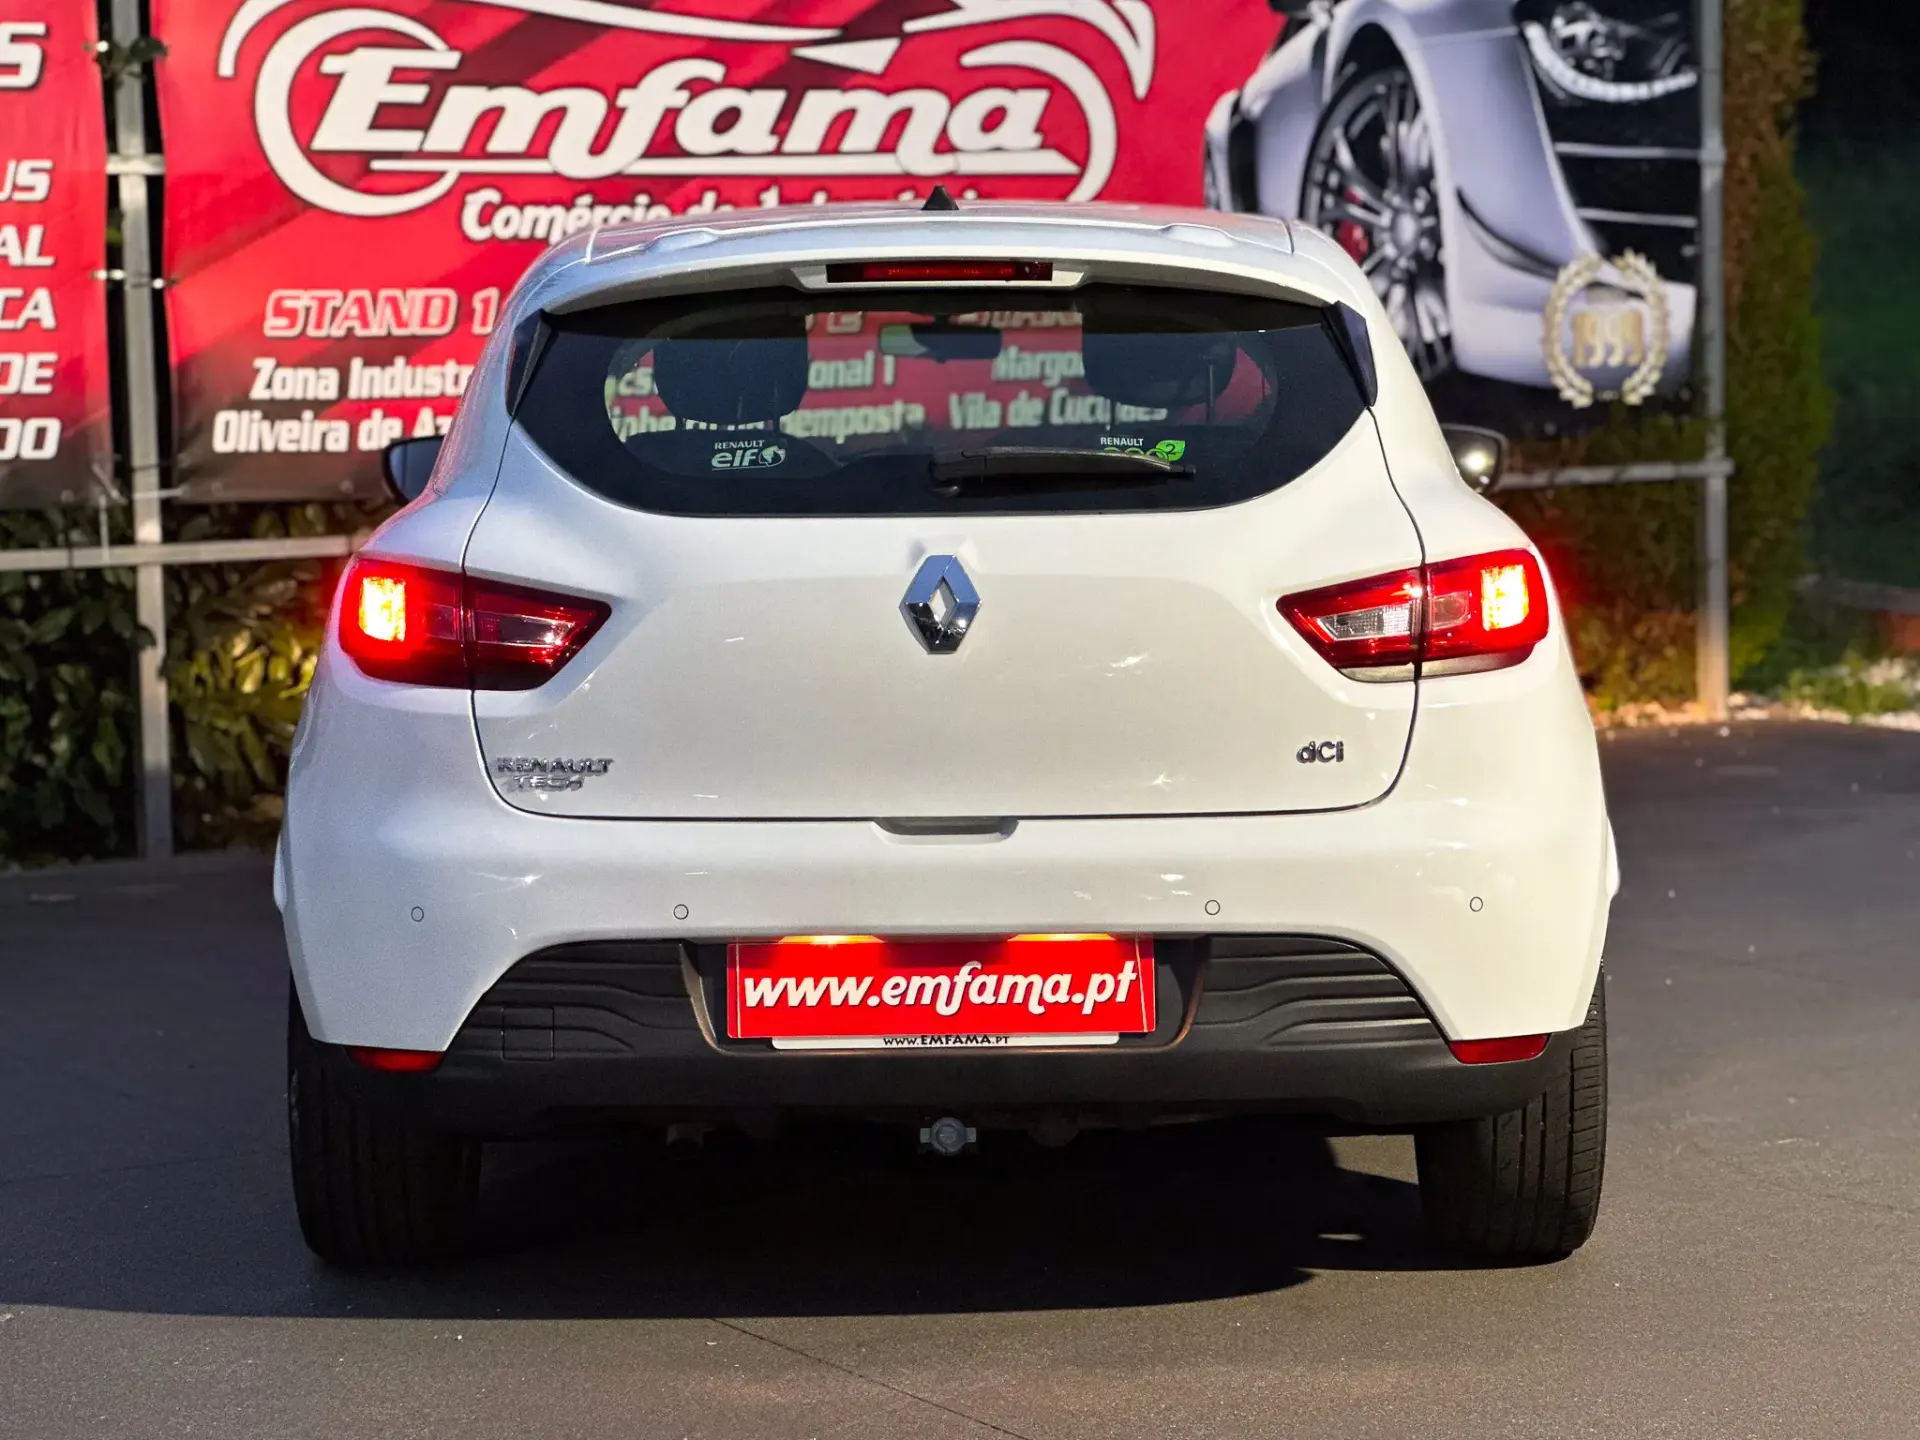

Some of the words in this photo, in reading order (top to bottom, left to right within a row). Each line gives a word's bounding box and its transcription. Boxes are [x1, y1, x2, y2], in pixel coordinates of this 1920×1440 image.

[311, 48, 1052, 179] Emfama
[263, 288, 458, 337] STAND
[249, 357, 340, 401] Zona
[212, 409, 350, 453] Oliveira
[357, 407, 404, 451] de
[714, 440, 765, 449] RENAULT
[1100, 437, 1144, 446] RENAULT
[496, 757, 613, 774] RENAULT
[744, 961, 1137, 1016] www.emfama.pt
